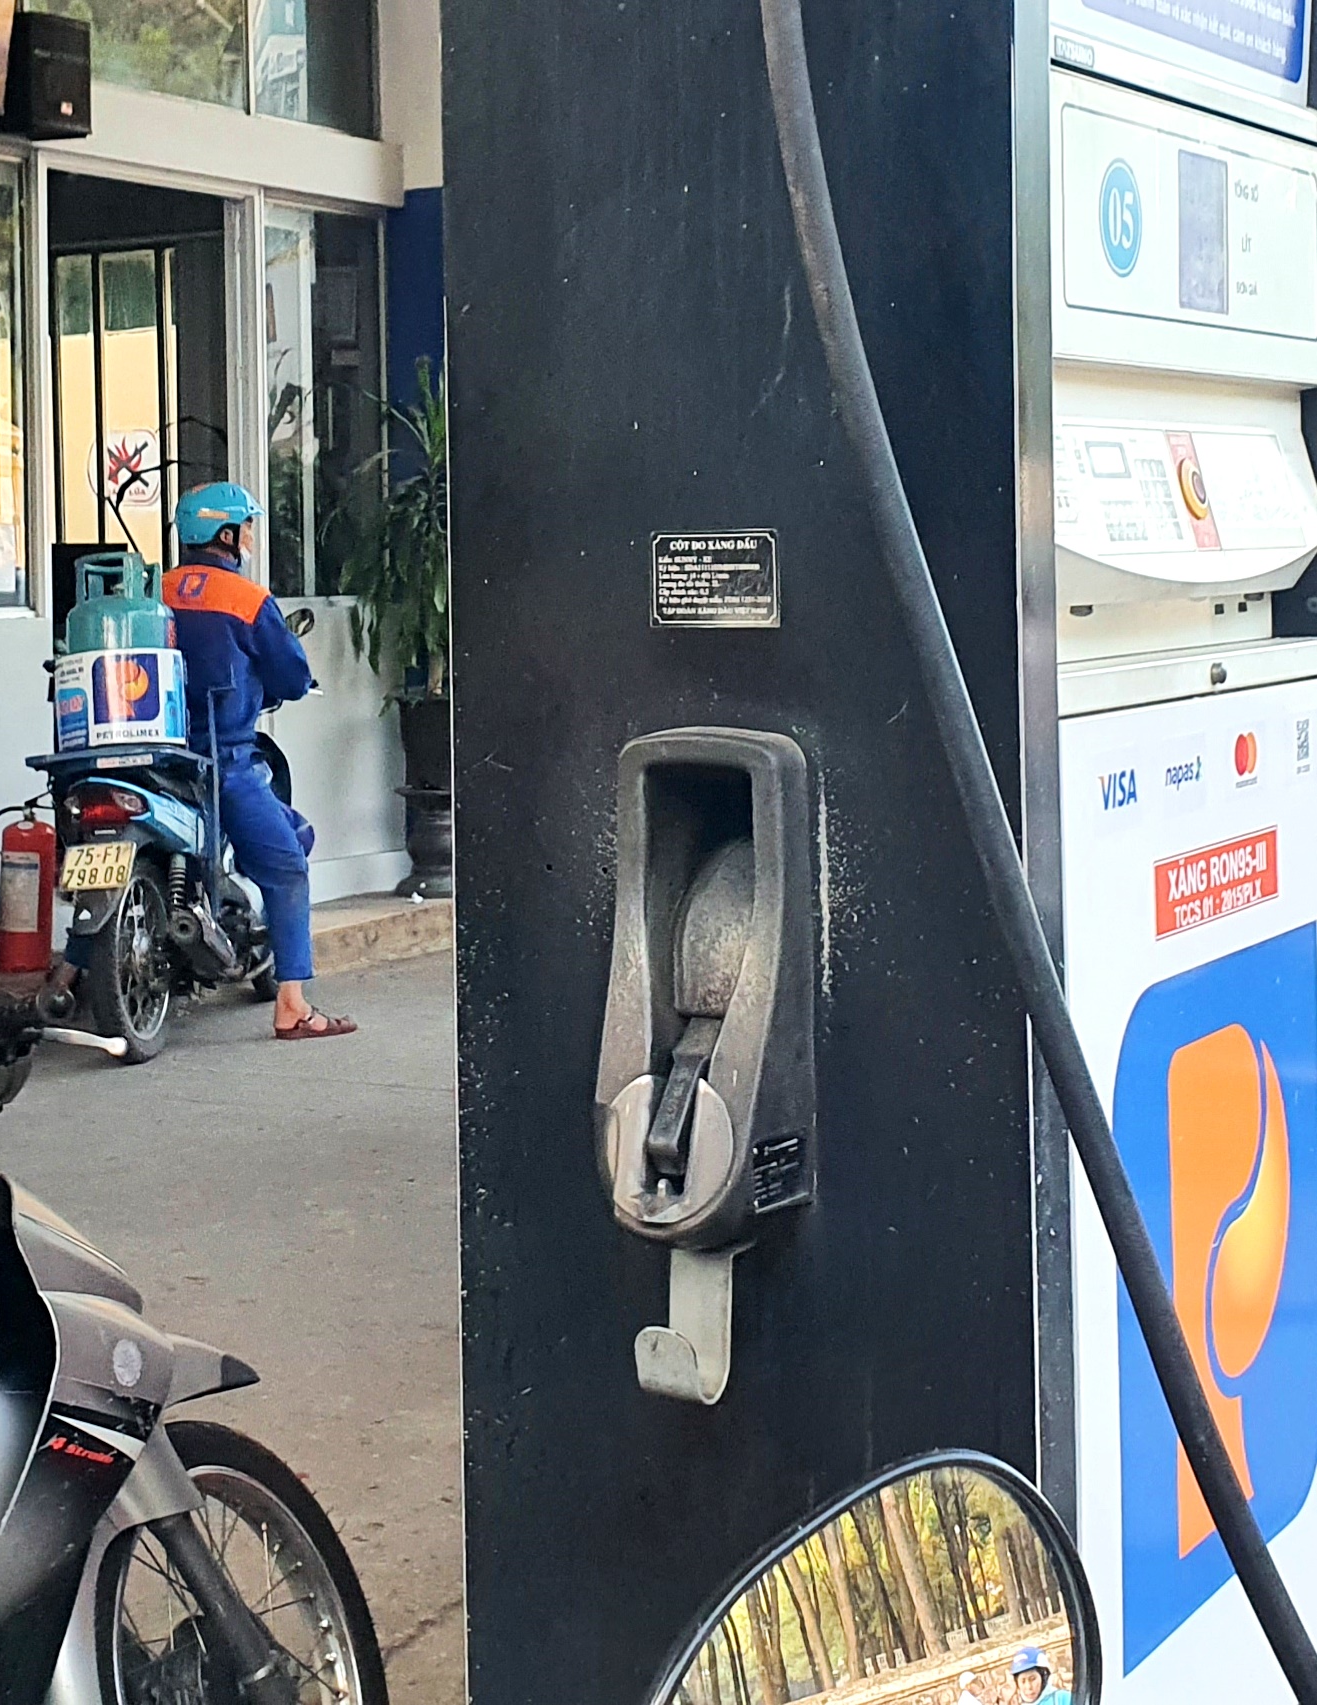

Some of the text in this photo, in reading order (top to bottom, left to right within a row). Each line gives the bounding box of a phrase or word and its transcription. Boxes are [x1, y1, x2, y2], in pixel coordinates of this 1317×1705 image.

[1108, 187, 1134, 250] 05
[669, 539, 690, 551] CỘT
[96, 729, 160, 740] PETROLIMEX
[1098, 769, 1138, 810] VISA
[1165, 762, 1195, 790] napas
[65, 865, 126, 888] 798.08
[1167, 841, 1267, 902] XĂNG RON95-III
[1174, 901, 1202, 928] TCCS
